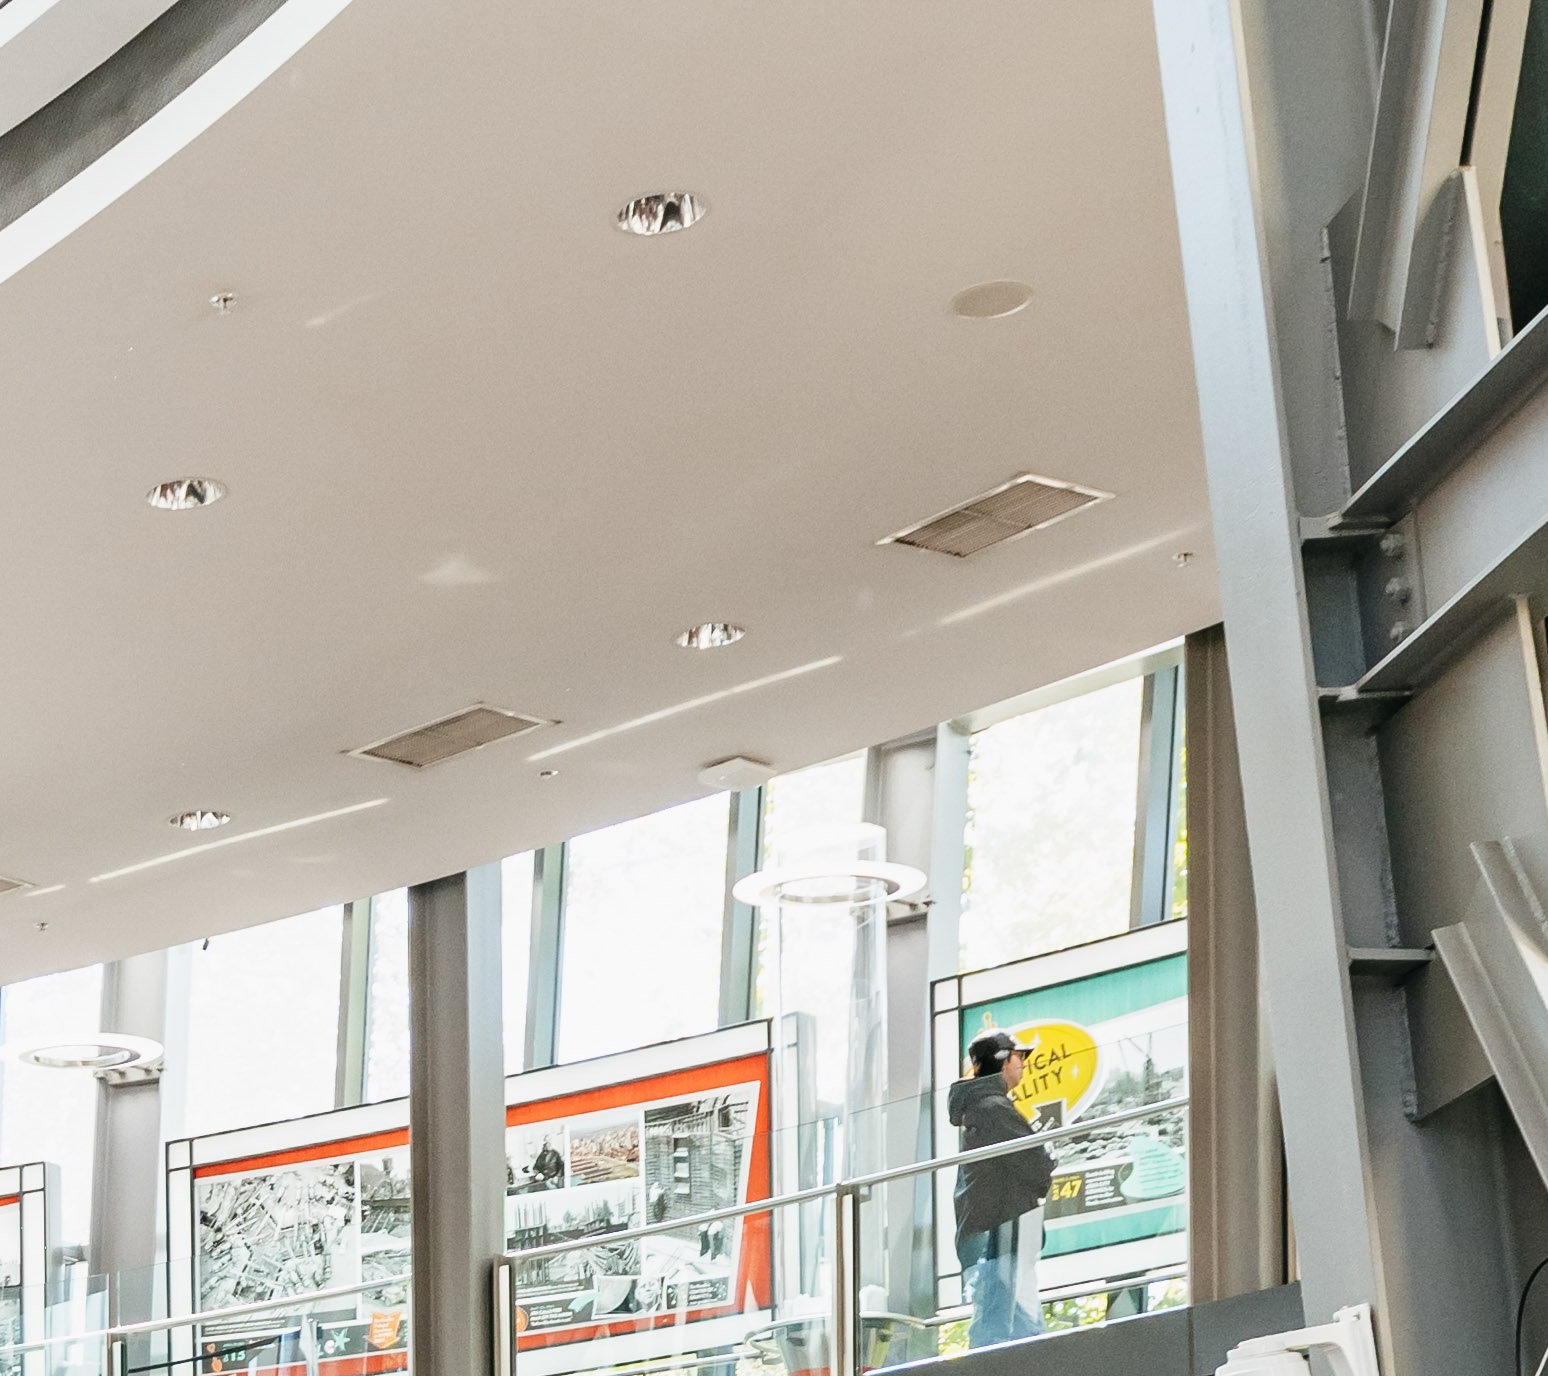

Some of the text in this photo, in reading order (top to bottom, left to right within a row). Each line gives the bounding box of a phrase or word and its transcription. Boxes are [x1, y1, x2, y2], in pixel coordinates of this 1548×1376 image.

[1024, 1042, 1072, 1075] ICAL
[1010, 1066, 1064, 1104] ALITY
[1060, 1179, 1083, 1199] 47
